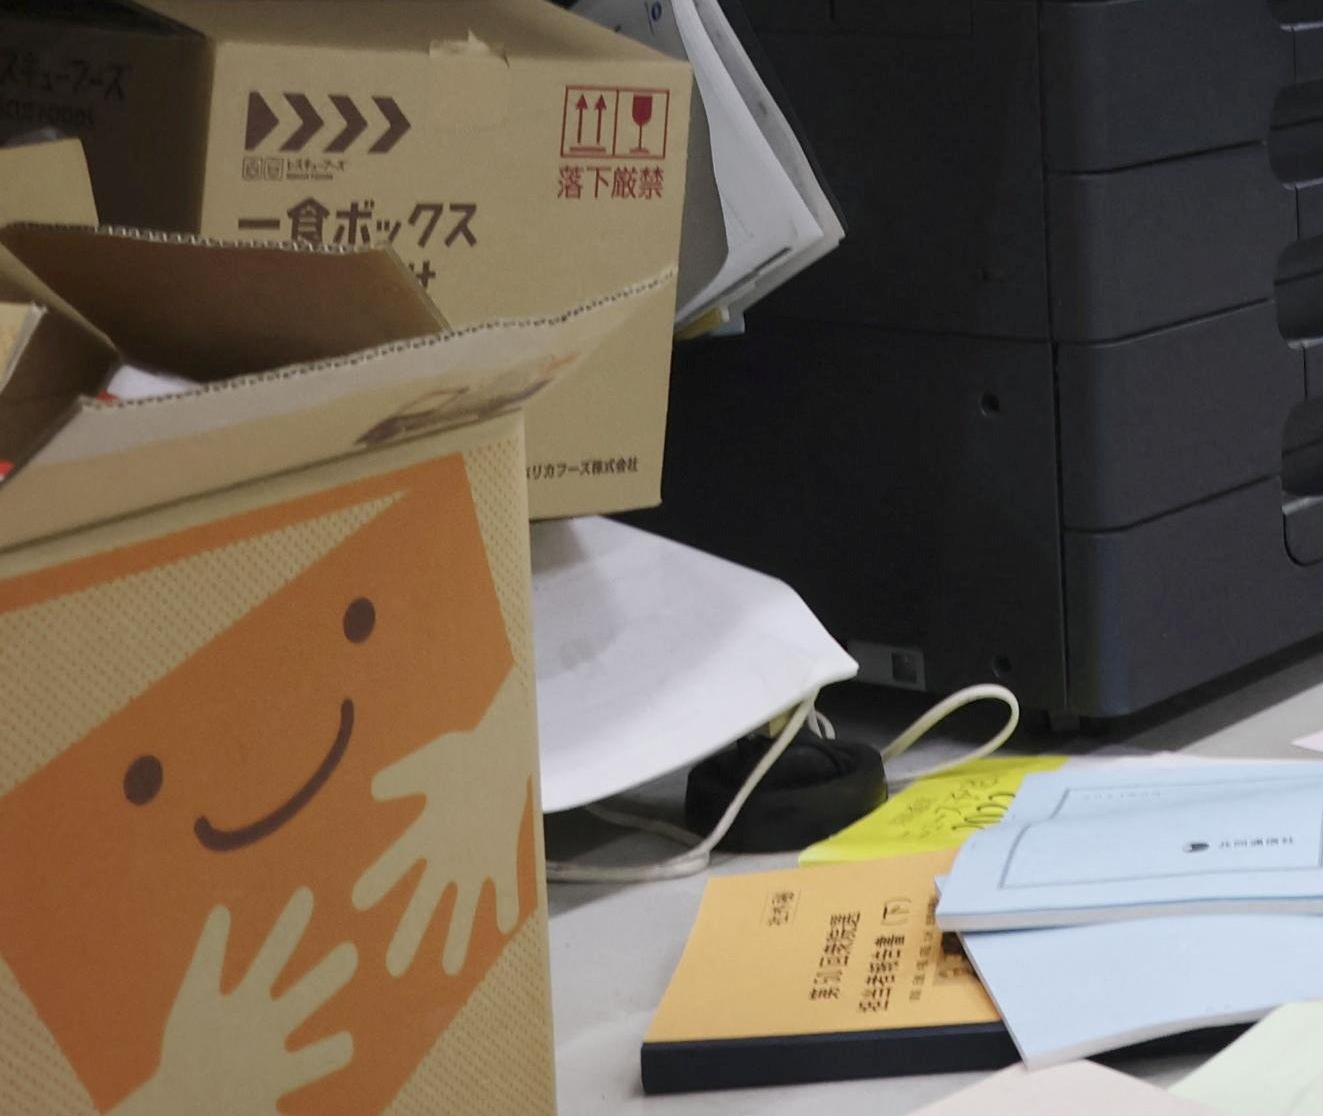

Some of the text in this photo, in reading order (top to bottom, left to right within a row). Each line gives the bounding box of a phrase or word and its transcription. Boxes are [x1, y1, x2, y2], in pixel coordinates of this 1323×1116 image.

[557, 165, 666, 202] 落下厳禁
[237, 196, 478, 249] 一食ボックス
